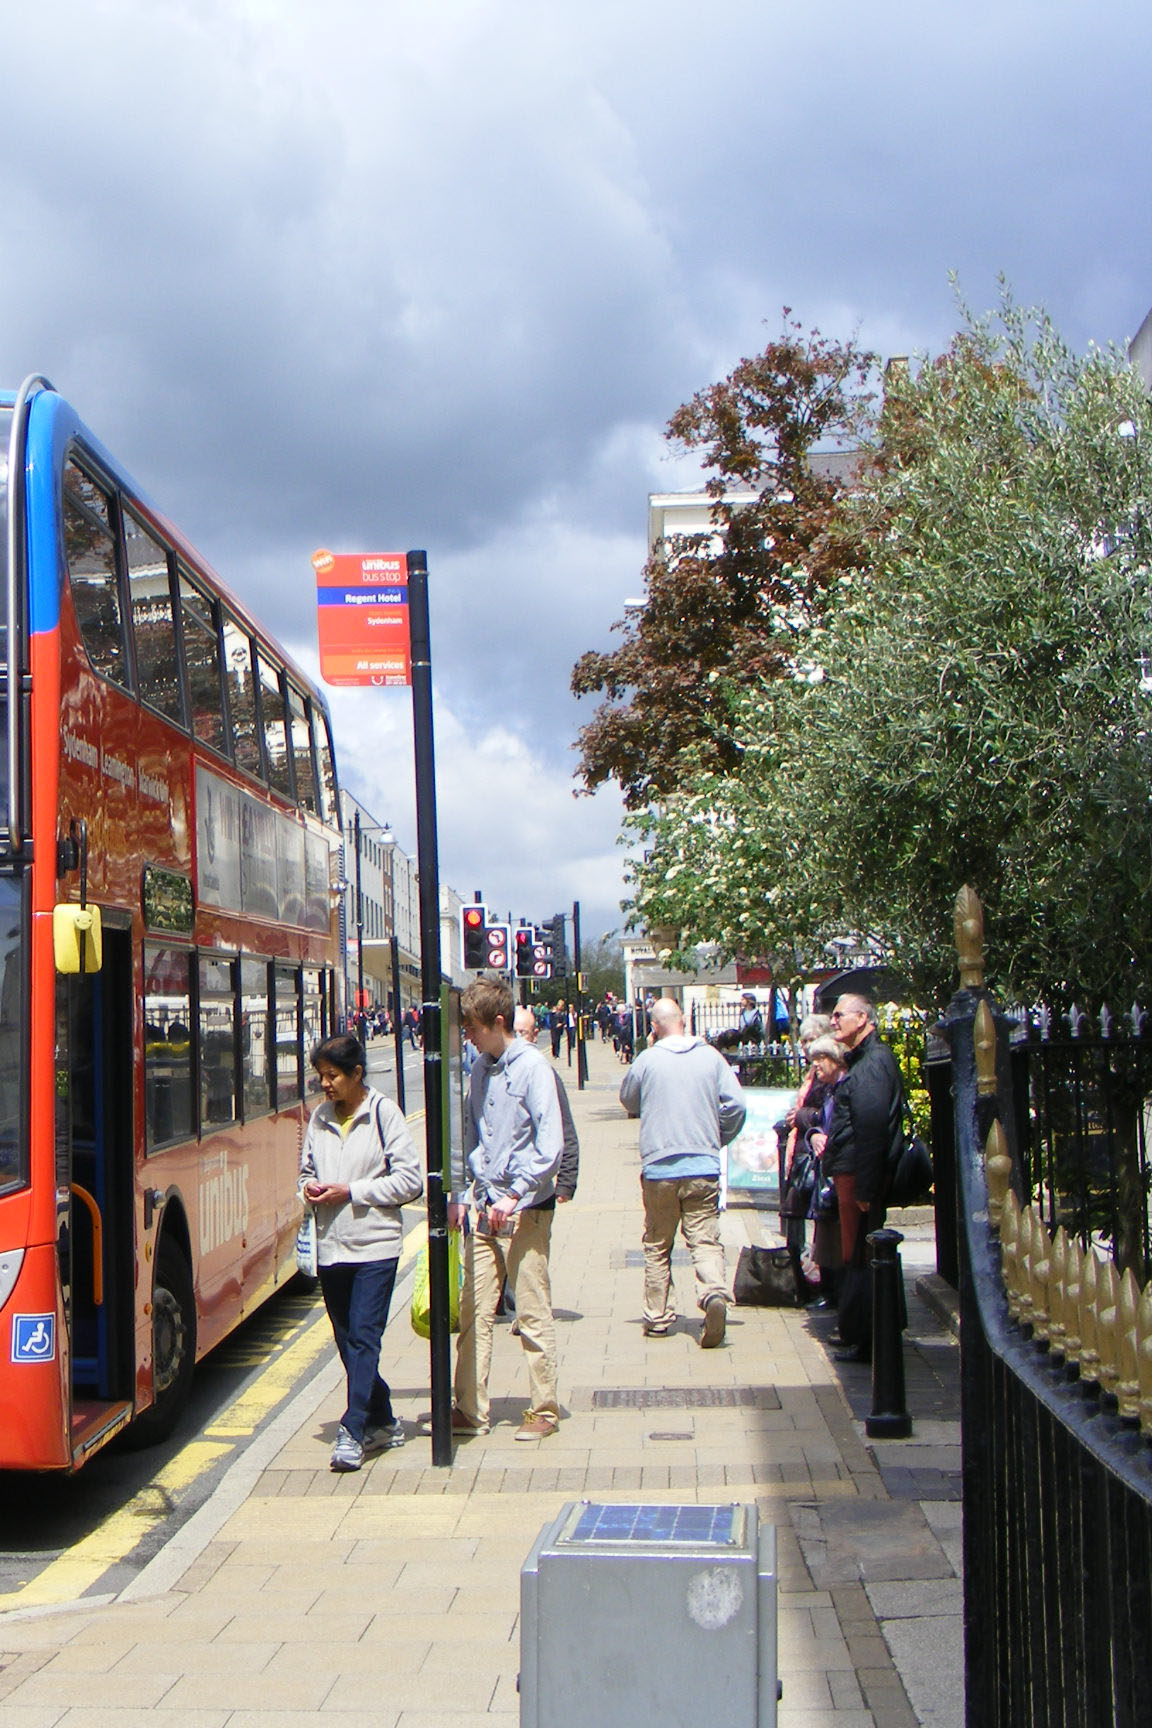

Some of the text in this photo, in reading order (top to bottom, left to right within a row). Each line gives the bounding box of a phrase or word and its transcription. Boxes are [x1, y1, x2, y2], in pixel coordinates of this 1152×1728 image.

[362, 559, 400, 570] unibus
[362, 572, 401, 583] bus stop
[345, 593, 402, 604] Regent Hotel
[367, 617, 403, 626] Sydenham
[356, 661, 404, 670] All services
[199, 1150, 249, 1256] unibus
